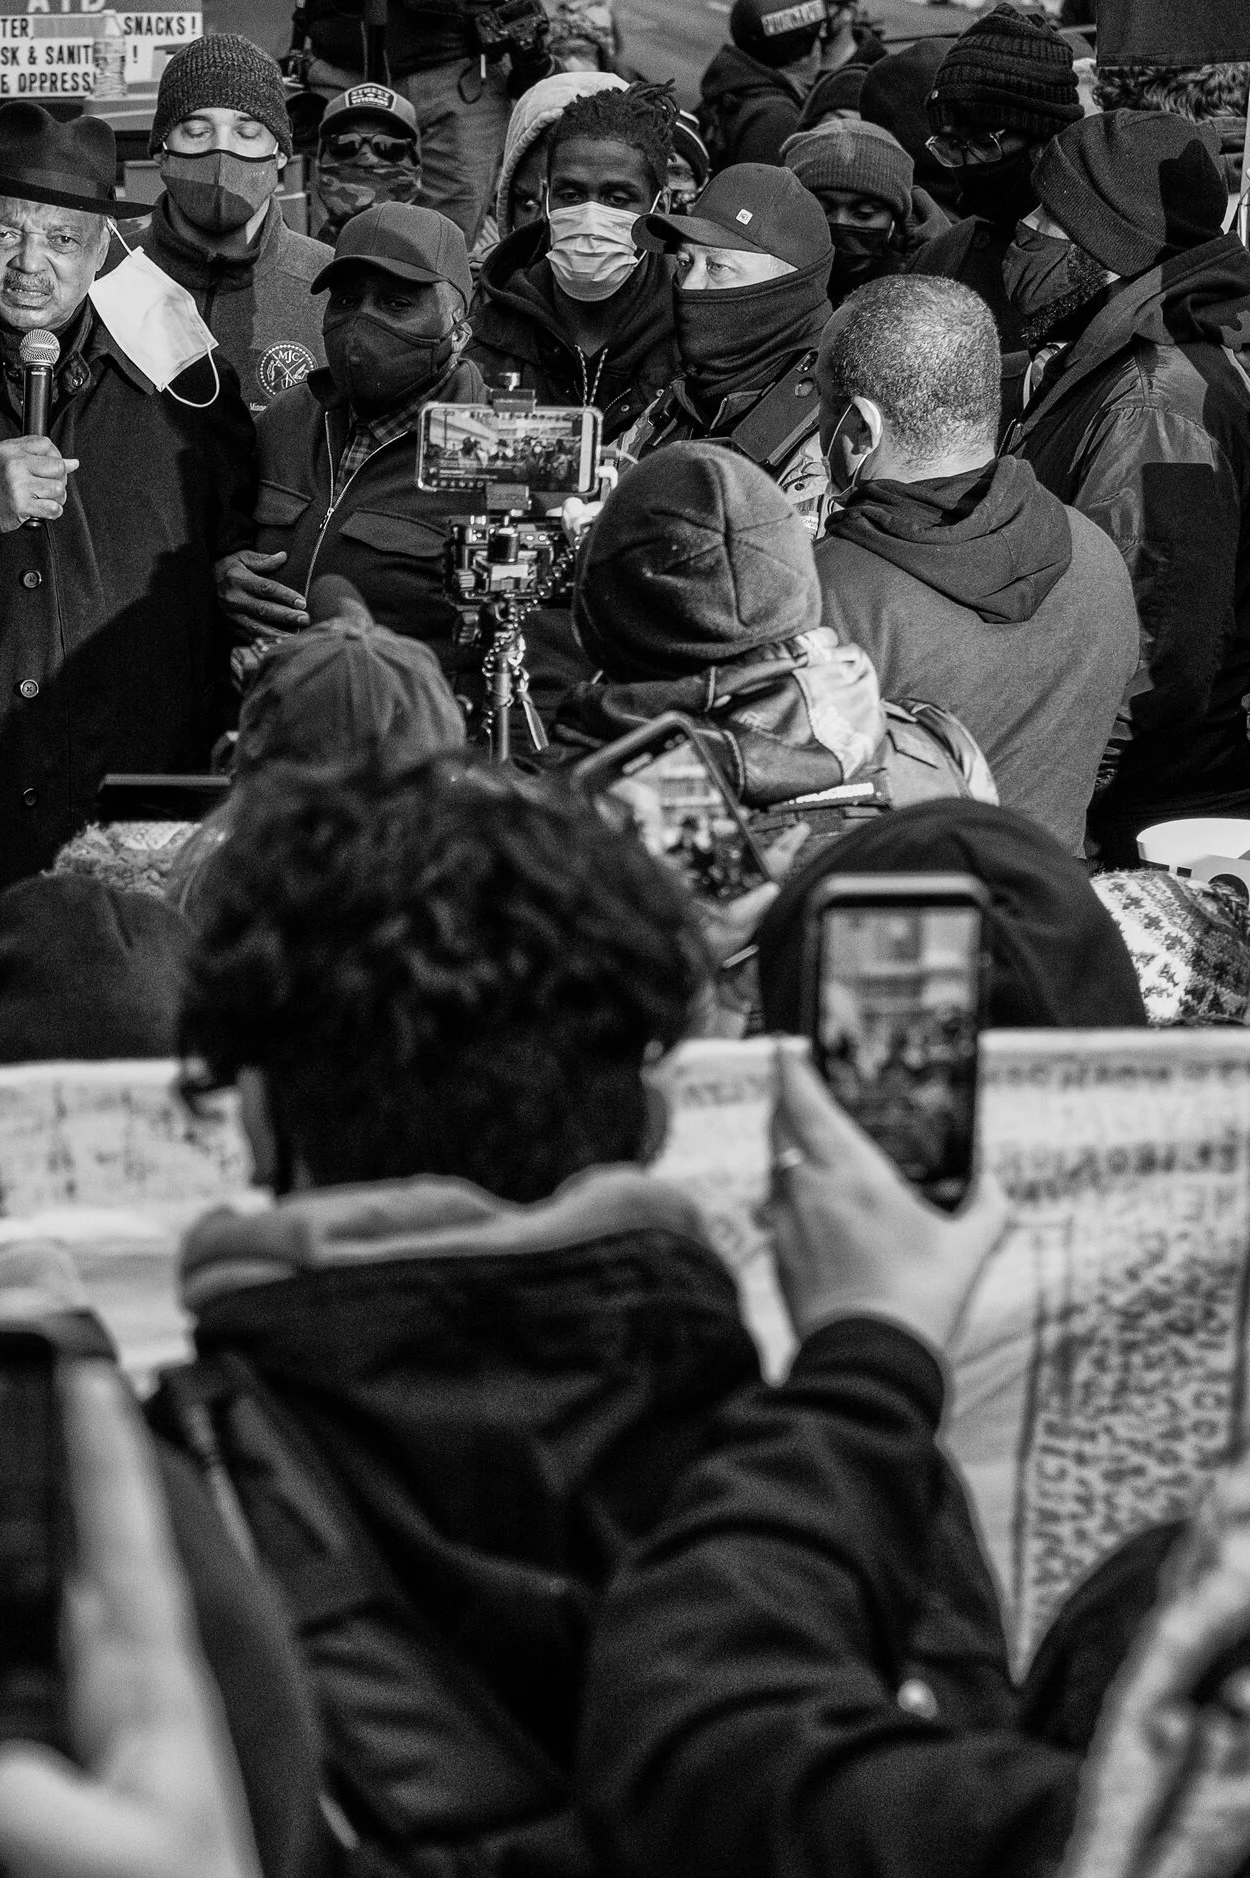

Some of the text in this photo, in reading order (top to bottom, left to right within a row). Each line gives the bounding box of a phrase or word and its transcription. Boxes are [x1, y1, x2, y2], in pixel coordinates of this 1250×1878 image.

[27, 46, 38, 65] &
[45, 45, 91, 65] SANIT
[17, 72, 96, 93] OPPRESS
[278, 348, 301, 364] MJC
